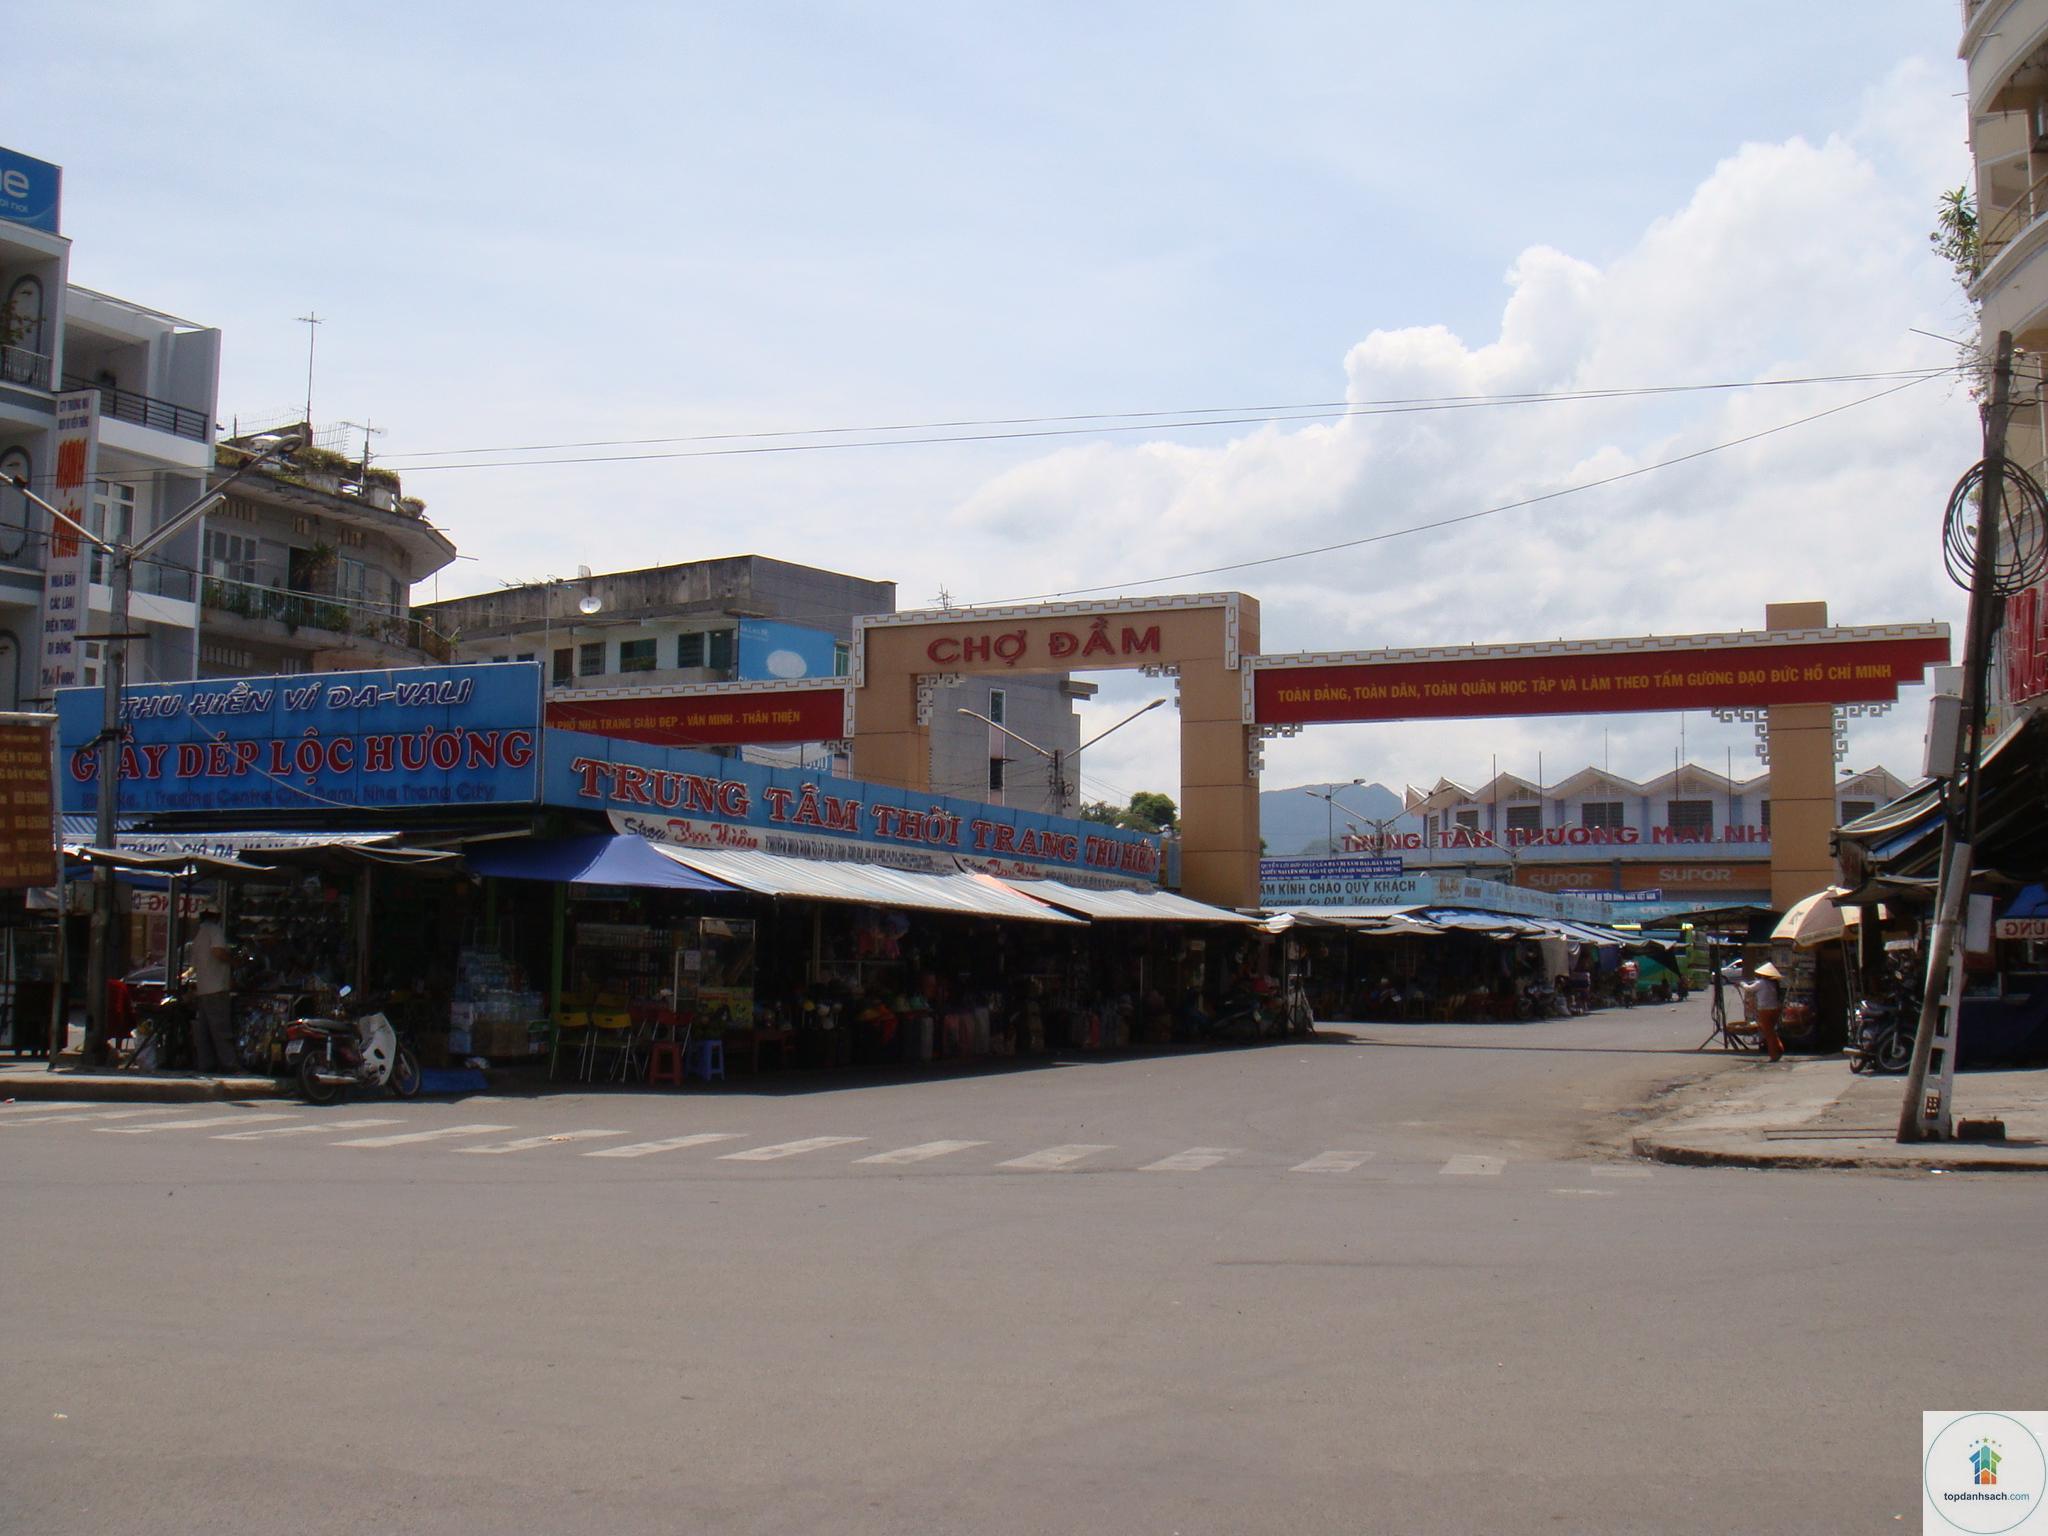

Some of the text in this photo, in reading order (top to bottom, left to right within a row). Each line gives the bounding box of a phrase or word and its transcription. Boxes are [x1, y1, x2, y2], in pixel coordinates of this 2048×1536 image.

[927, 617, 1161, 665] CHỢ ĐẦM
[1278, 686, 1310, 702] TOÀN
[1314, 684, 1351, 702] ĐẢNG,
[1353, 684, 1387, 699] TOÀN
[1391, 682, 1420, 699] DÂN,
[1424, 680, 1457, 697] TOÀN
[1461, 679, 1496, 697] QUÂN
[1500, 679, 1527, 696] HỌC
[1531, 676, 1557, 695] TẬP
[1561, 675, 1577, 691] VÀ
[1582, 674, 1611, 691] LÀM
[1615, 675, 1649, 689] THEO
[1687, 670, 1733, 687] GƯƠNG
[1738, 669, 1765, 687] ĐẠO
[1771, 665, 1799, 682] ĐỨC
[1804, 663, 1823, 680] HỒ
[1828, 663, 1851, 680] CHÍ
[1855, 664, 1891, 679] MINH
[120, 694, 183, 719] THU
[187, 681, 273, 716] HIỀN
[283, 681, 321, 711] VÍ
[600, 716, 631, 730] TRANG
[709, 713, 733, 726] MINH
[176, 731, 260, 778] DÉP
[268, 725, 353, 785] LỘC
[363, 724, 534, 772] HƯƠNG
[456, 781, 496, 801] City
[571, 756, 750, 818] TRUNG
[764, 782, 862, 833] TÂM
[871, 803, 963, 847] THỜI
[971, 819, 1080, 863] TRANG
[1084, 834, 1117, 868] THU
[1279, 880, 1305, 894] KÍNH
[1309, 879, 1341, 893] CHÀO
[1345, 878, 1370, 893] QUÝ
[1374, 878, 1416, 893] KHÁCH
[1528, 872, 1592, 888] SUPOR
[1658, 868, 1731, 883] SUPOR
